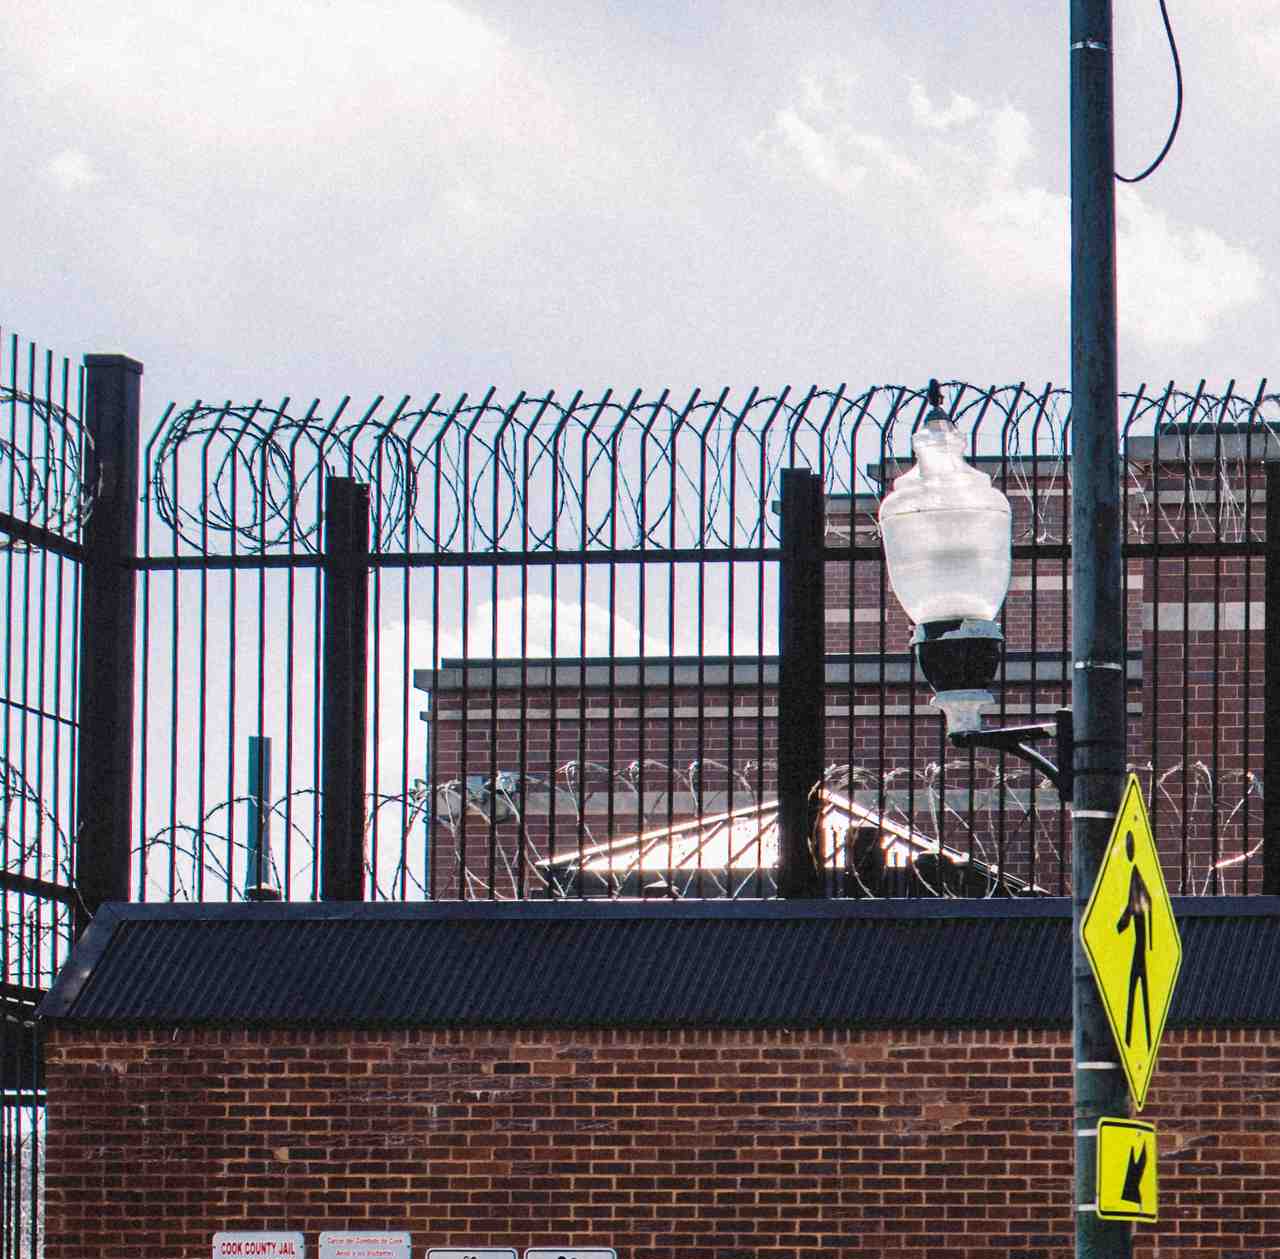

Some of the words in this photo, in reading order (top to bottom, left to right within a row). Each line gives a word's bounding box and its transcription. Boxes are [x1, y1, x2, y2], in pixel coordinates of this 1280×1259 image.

[221, 1242, 242, 1255] COOK
[245, 1242, 276, 1255] COUNTY
[279, 1242, 296, 1255] JAIL
